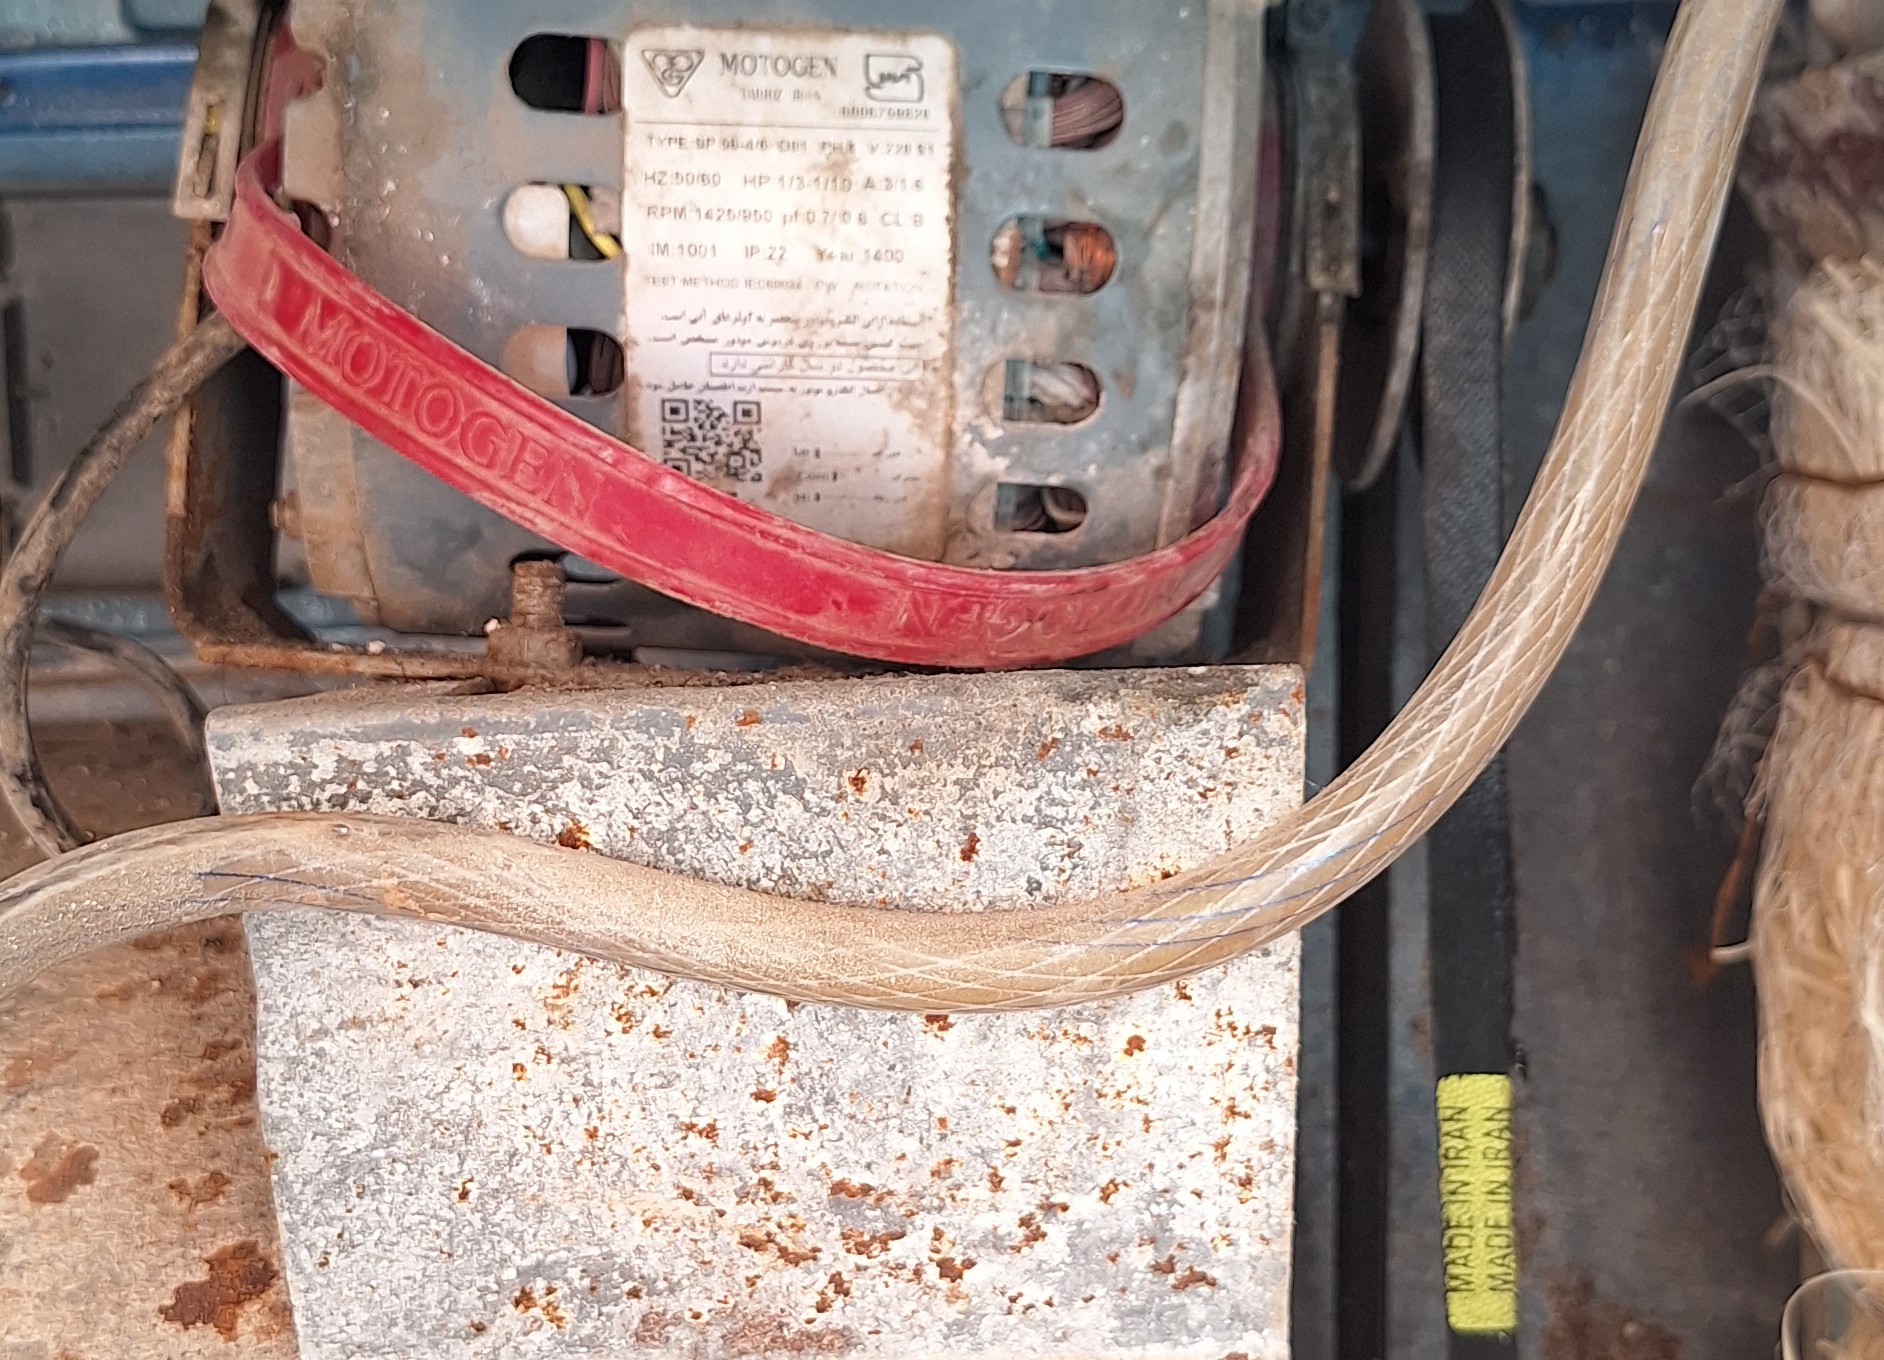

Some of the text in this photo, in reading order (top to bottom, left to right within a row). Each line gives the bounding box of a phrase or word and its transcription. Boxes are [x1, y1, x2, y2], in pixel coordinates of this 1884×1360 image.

[719, 51, 839, 79] MOTOGEN
[297, 294, 605, 520] MOTOGEN
[1439, 1104, 1475, 1292] MADE IN IRAN
[1482, 1105, 1517, 1292] MADE IN IRAN
